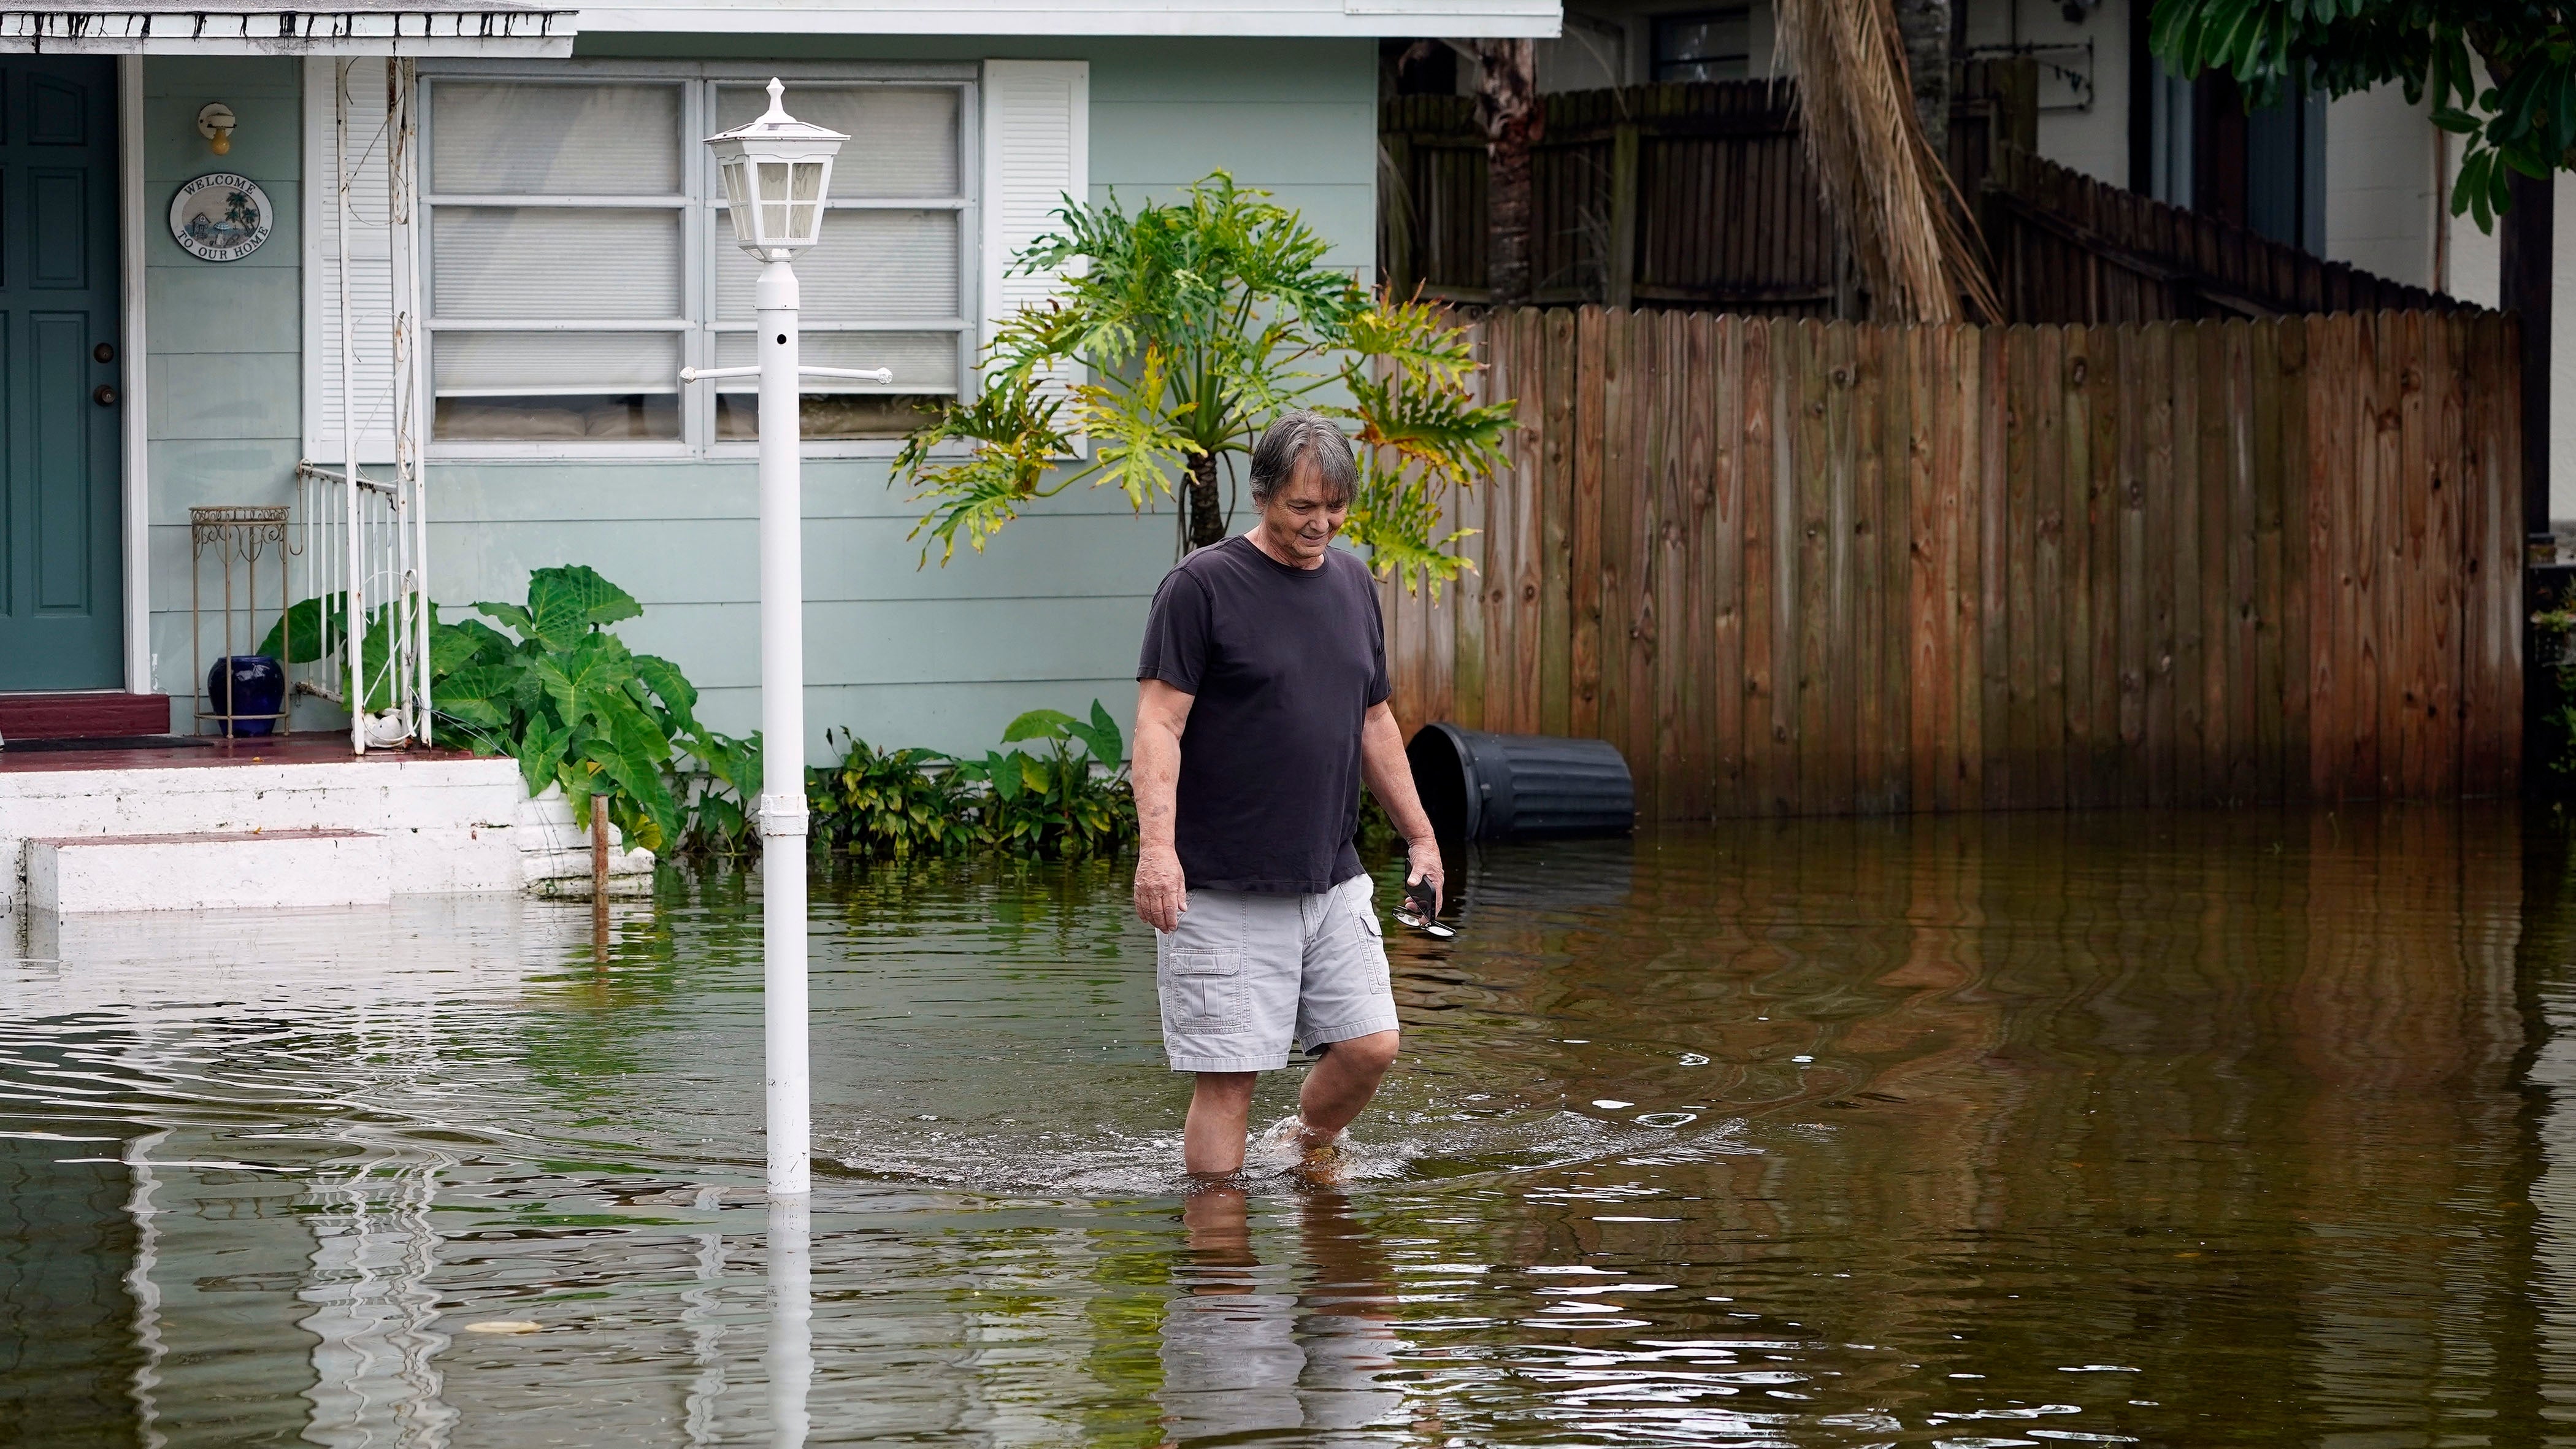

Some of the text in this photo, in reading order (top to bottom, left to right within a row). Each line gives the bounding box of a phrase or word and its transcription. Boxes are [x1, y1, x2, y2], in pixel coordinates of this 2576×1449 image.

[184, 175, 255, 195] WELCOME
[177, 226, 268, 259] TO OUR HOME
